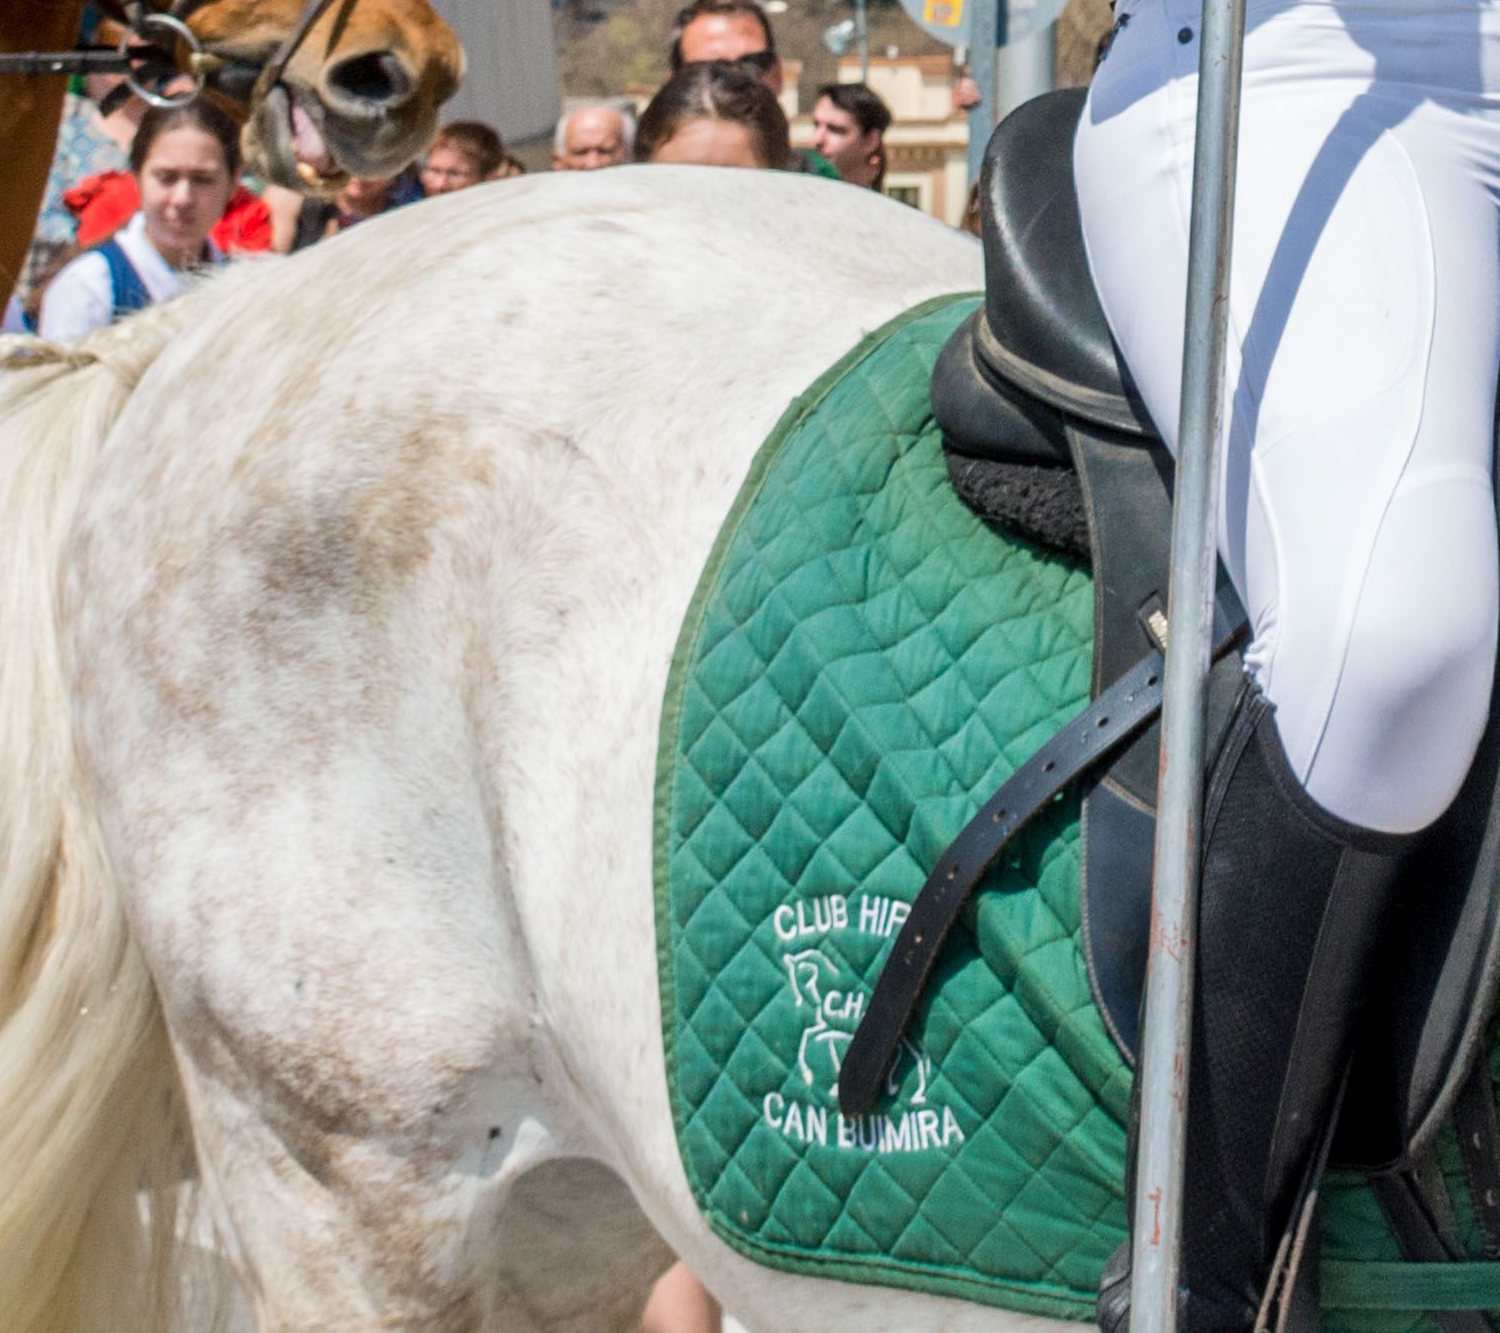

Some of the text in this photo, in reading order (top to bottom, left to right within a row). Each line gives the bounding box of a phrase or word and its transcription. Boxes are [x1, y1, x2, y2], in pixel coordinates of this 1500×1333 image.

[773, 894, 849, 941] CLUB
[763, 1092, 965, 1154] CAN BUIMIRA
